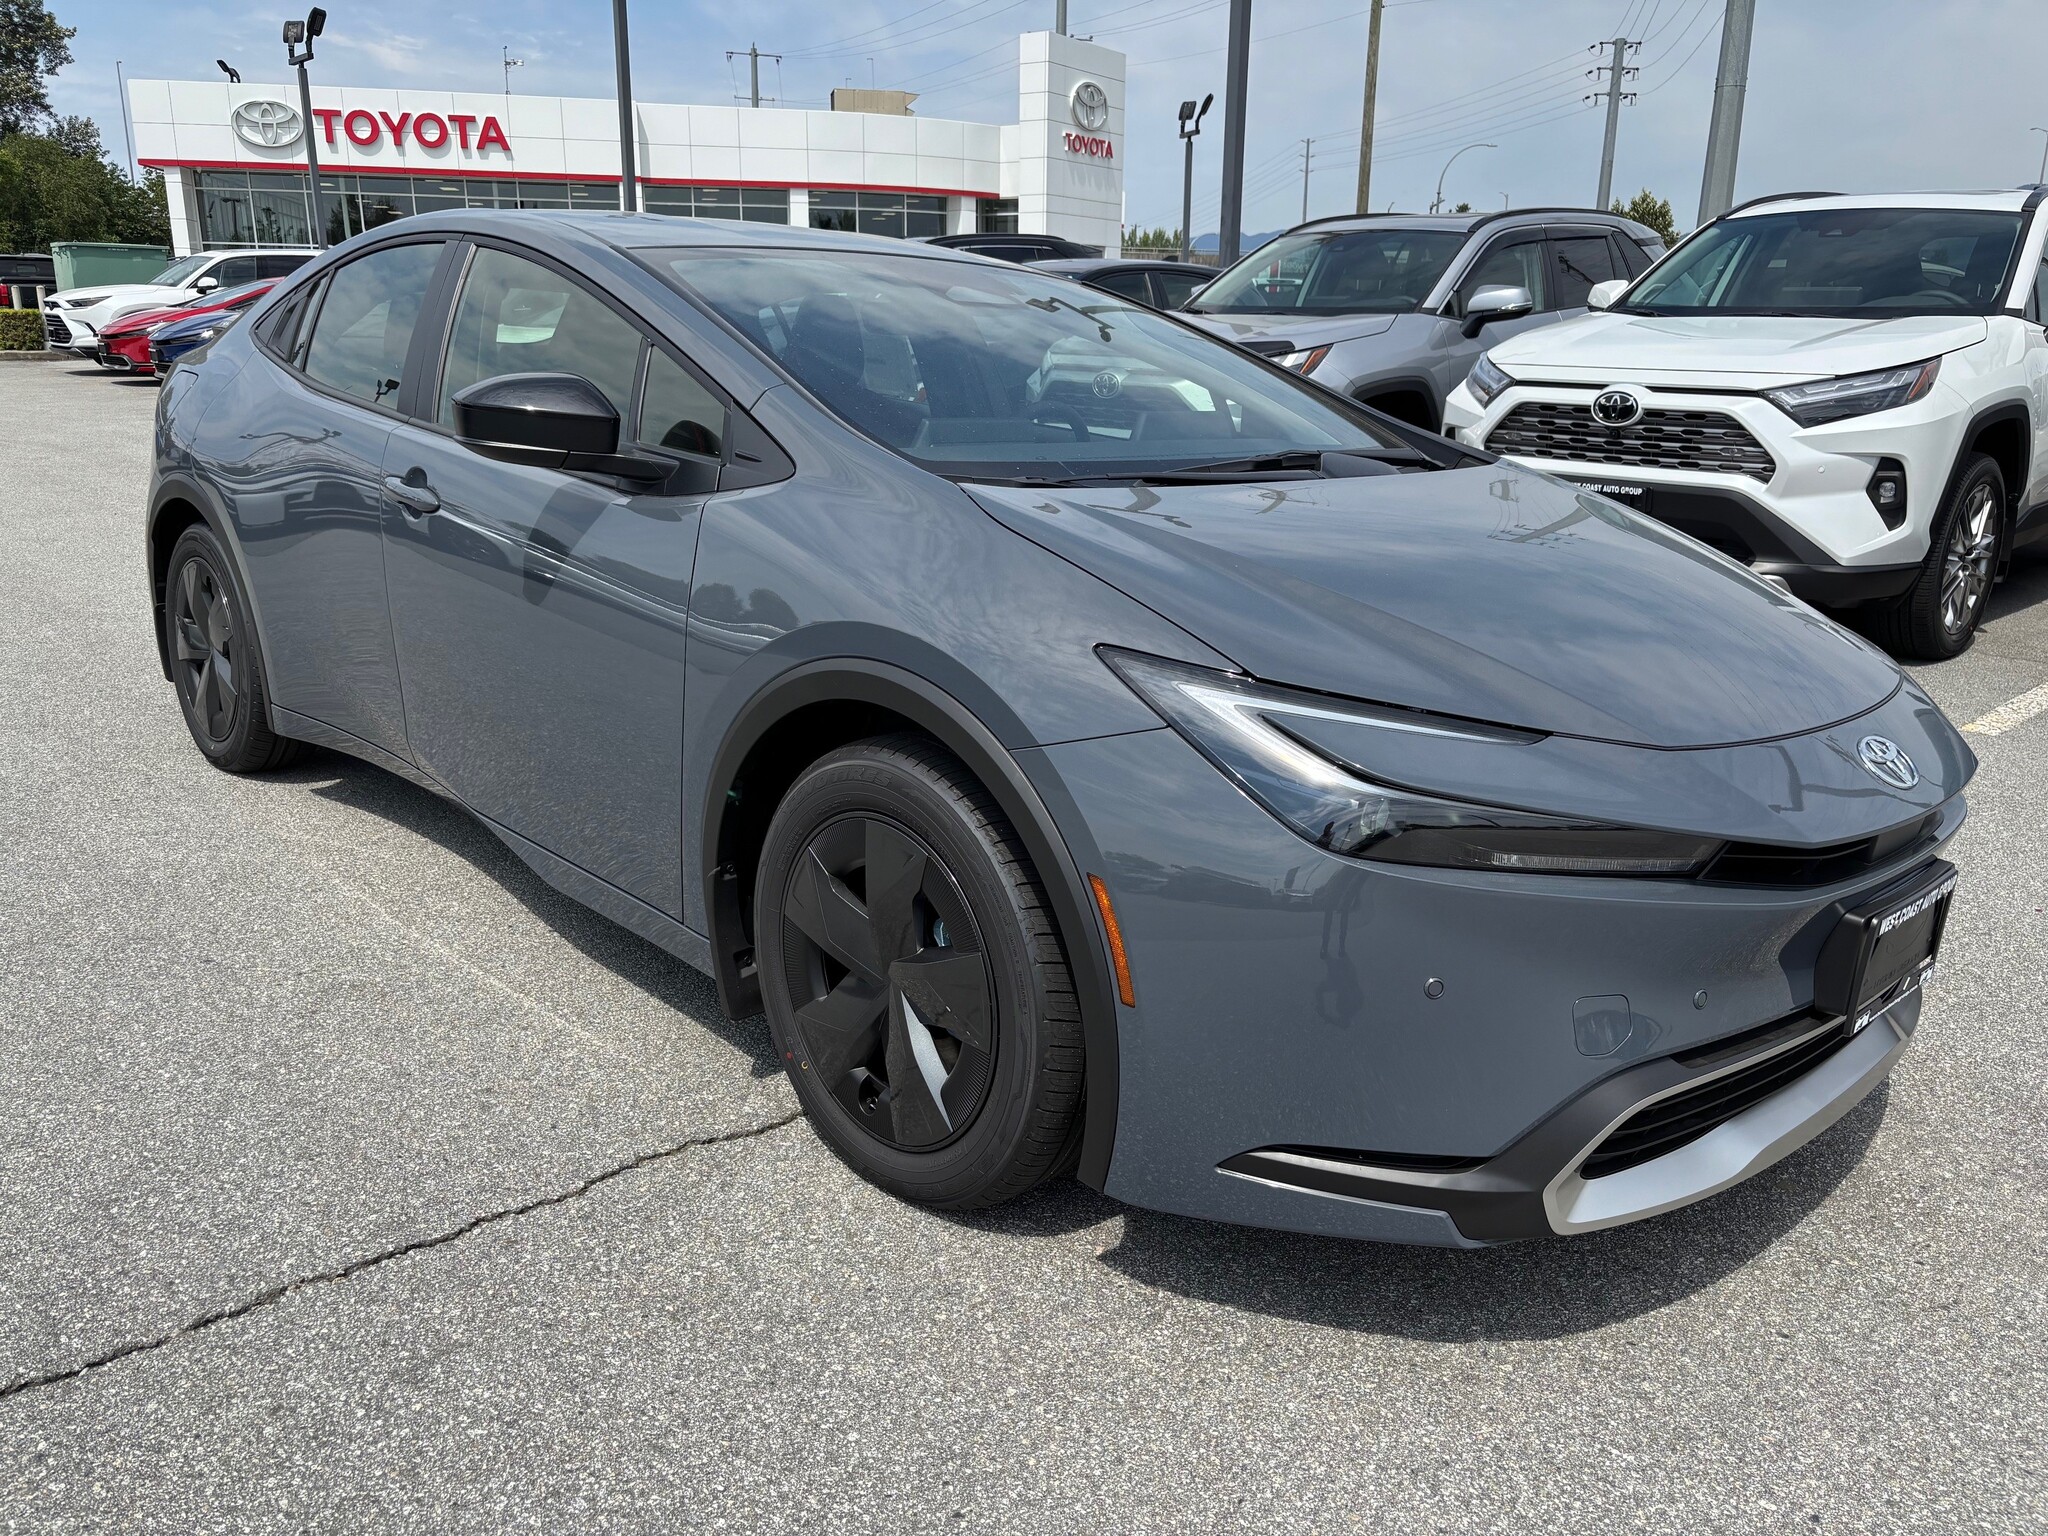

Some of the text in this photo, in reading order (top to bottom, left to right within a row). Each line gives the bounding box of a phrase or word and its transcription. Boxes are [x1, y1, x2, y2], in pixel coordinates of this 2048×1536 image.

[312, 108, 511, 151] TOYOTA
[1063, 132, 1113, 159] TOYOTA
[1603, 485, 1620, 494] AUTO
[1879, 910, 1901, 936] WEST
[1899, 897, 1924, 925] COAST
